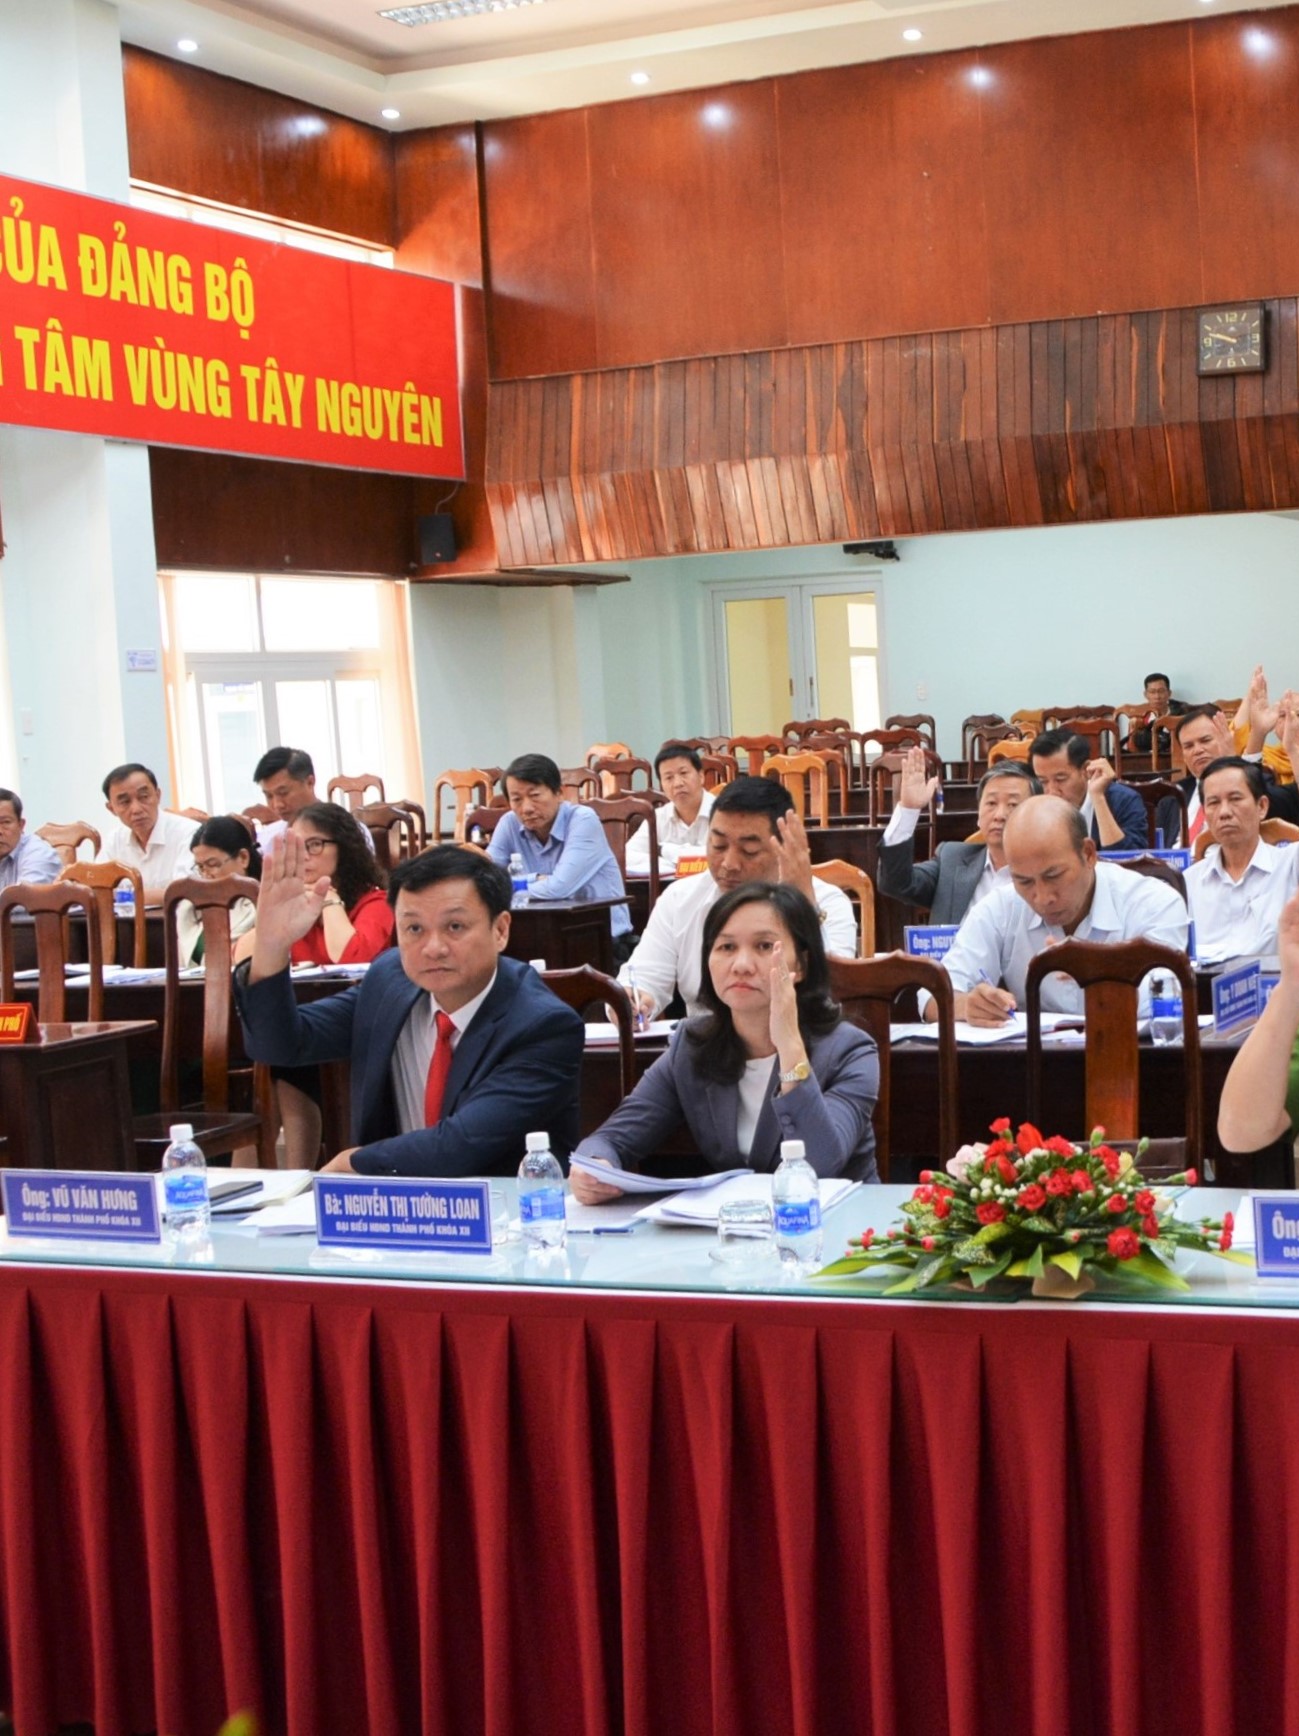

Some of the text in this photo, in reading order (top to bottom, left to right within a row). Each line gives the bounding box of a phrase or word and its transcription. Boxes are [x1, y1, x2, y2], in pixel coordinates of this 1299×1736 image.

[0, 196, 255, 340] ỦA ĐẢNG BỘ
[1225, 312, 1238, 322] 12
[1203, 337, 1212, 347] 9
[1251, 333, 1260, 343] 3
[1227, 357, 1236, 367] 6
[14, 317, 114, 402] TÂM
[123, 336, 232, 419] VÙNG
[240, 357, 304, 429] TÂY
[315, 381, 444, 448] NGUYÊN
[22, 1182, 50, 1209] Ông:
[72, 1185, 98, 1209] VĂN
[324, 1187, 480, 1222] Bà: NGUYỄN THỊ TƯỜNG LOAN
